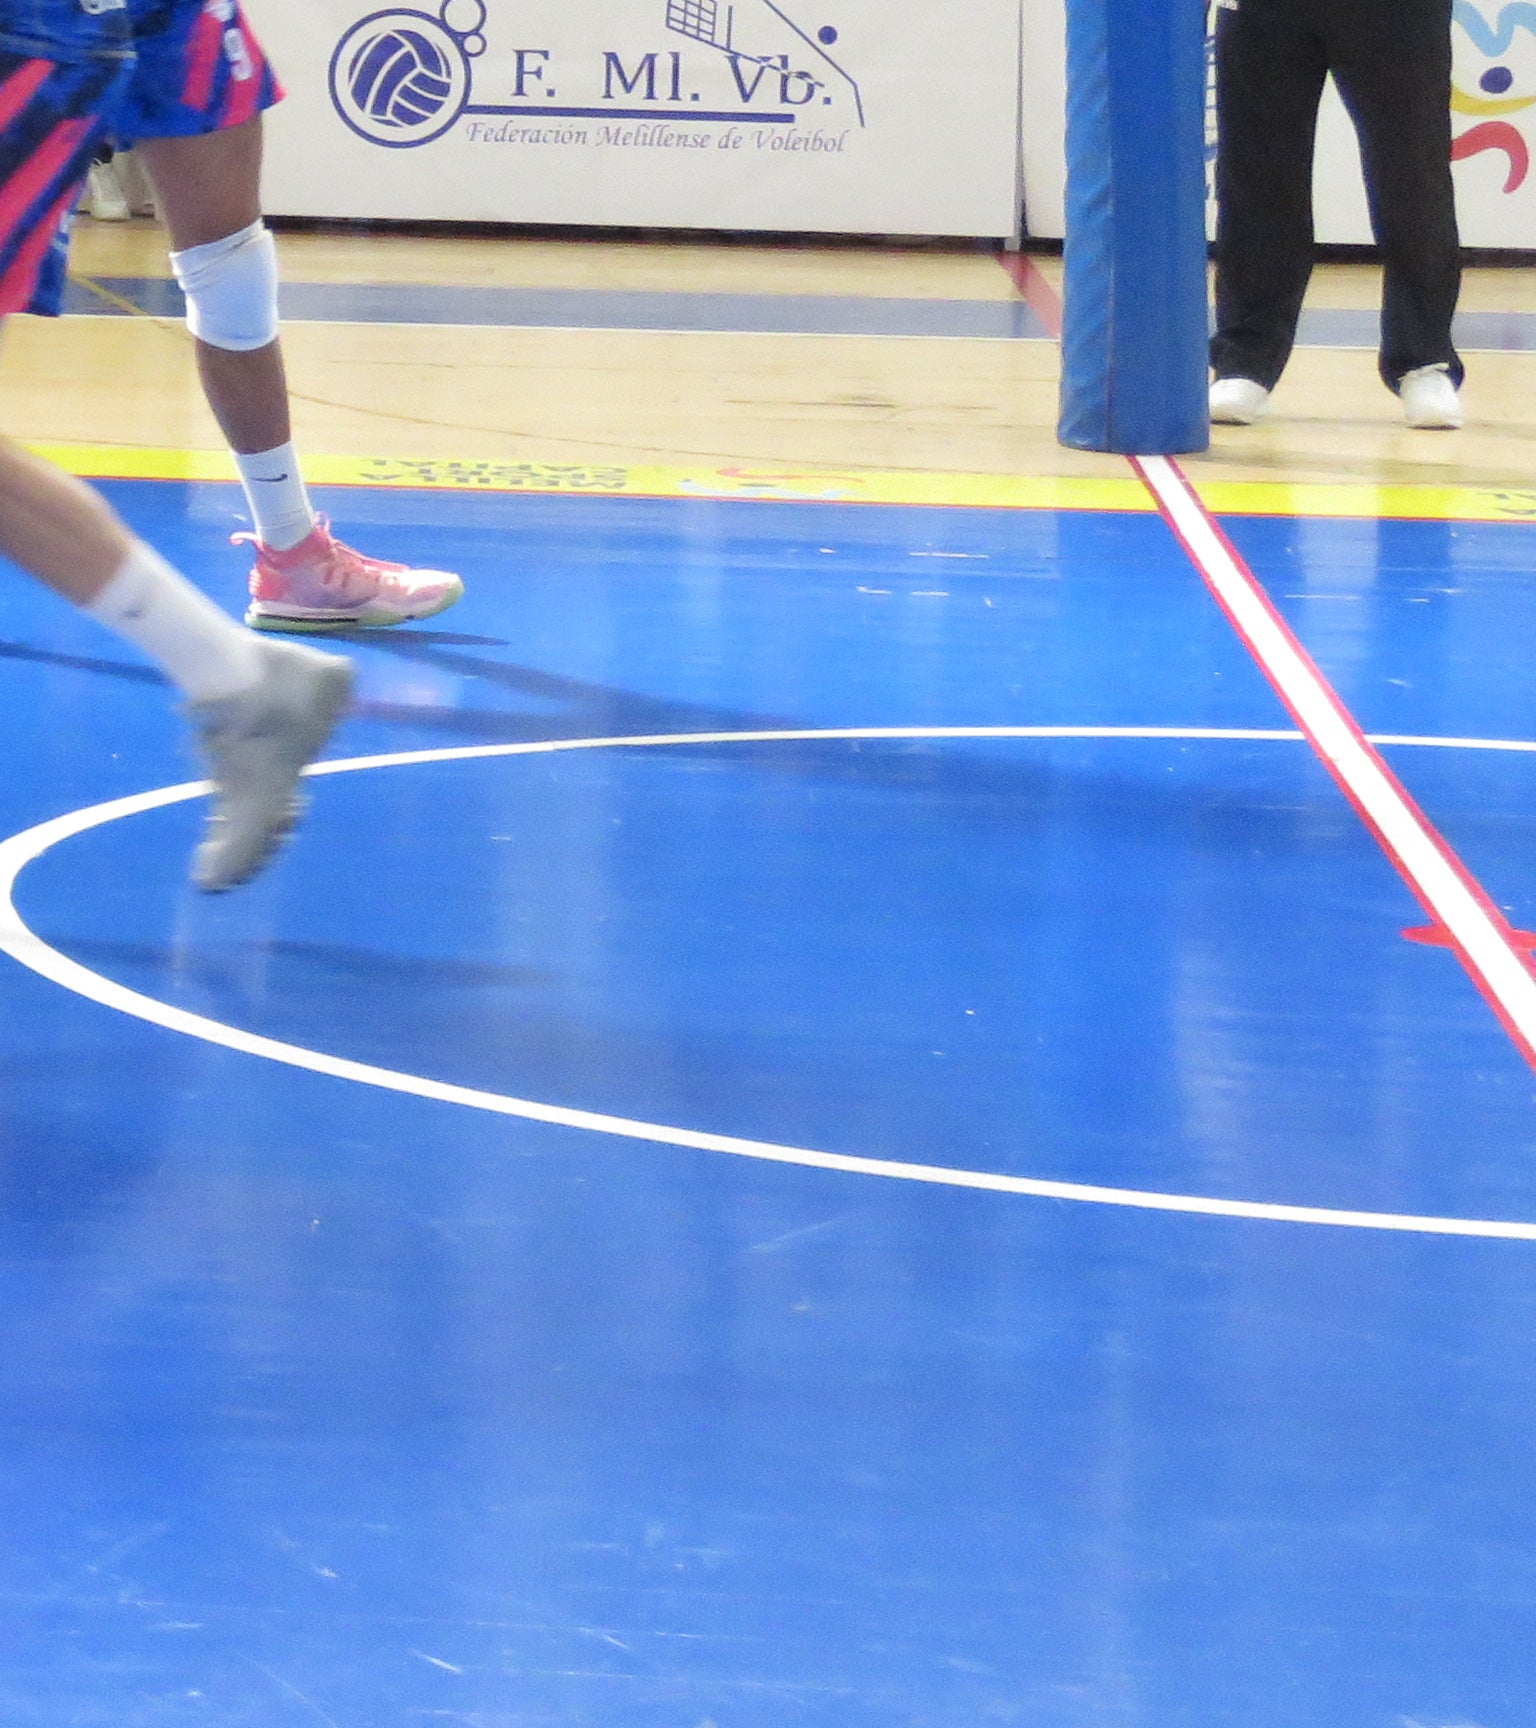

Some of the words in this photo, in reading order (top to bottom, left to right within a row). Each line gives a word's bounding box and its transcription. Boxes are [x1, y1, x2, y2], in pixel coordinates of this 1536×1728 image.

[511, 48, 556, 97] F.
[724, 54, 832, 106] Vb.
[465, 120, 587, 145] Federación
[595, 124, 710, 150] Melillense
[718, 128, 742, 150] de
[750, 128, 851, 154] Voleibol
